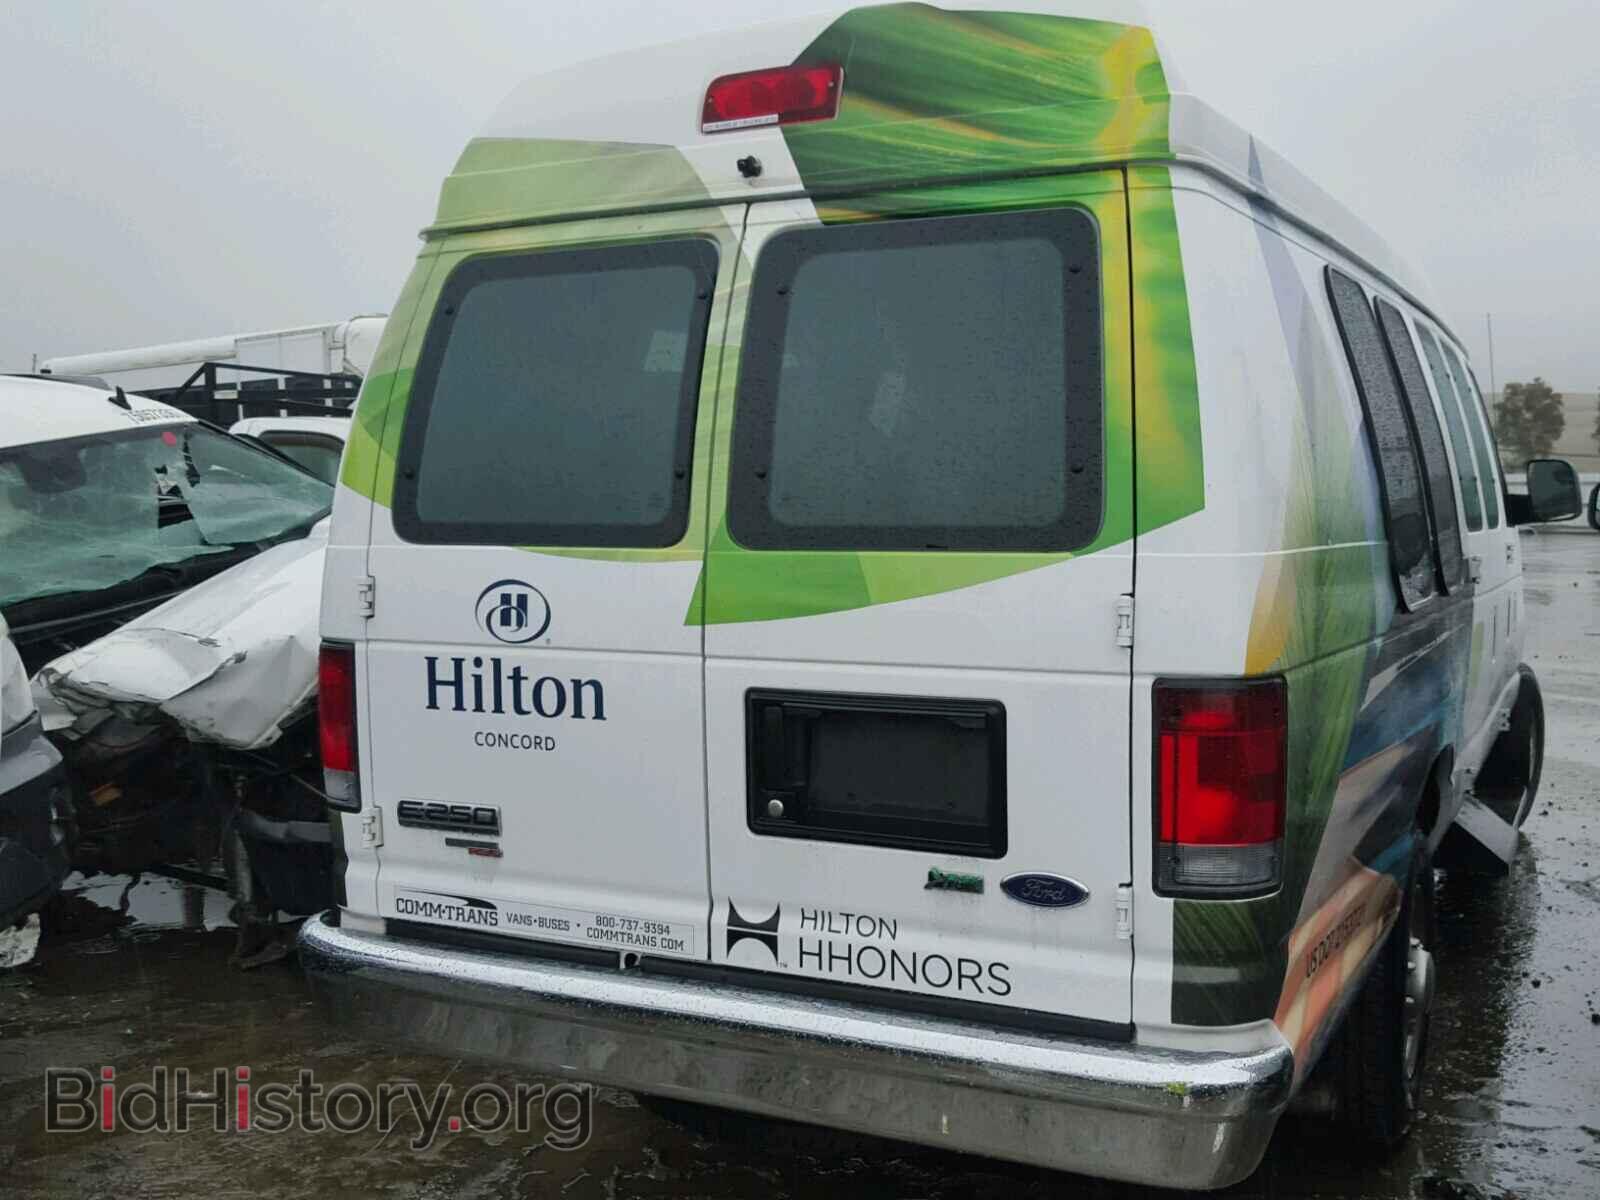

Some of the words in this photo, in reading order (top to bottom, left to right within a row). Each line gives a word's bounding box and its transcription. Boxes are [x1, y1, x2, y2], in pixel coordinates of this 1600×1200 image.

[424, 656, 607, 721] Hilton
[474, 730, 556, 752] CONCORD
[1020, 877, 1067, 901] Ford
[800, 907, 898, 941] HILTON
[799, 936, 1012, 997] HHONORS
